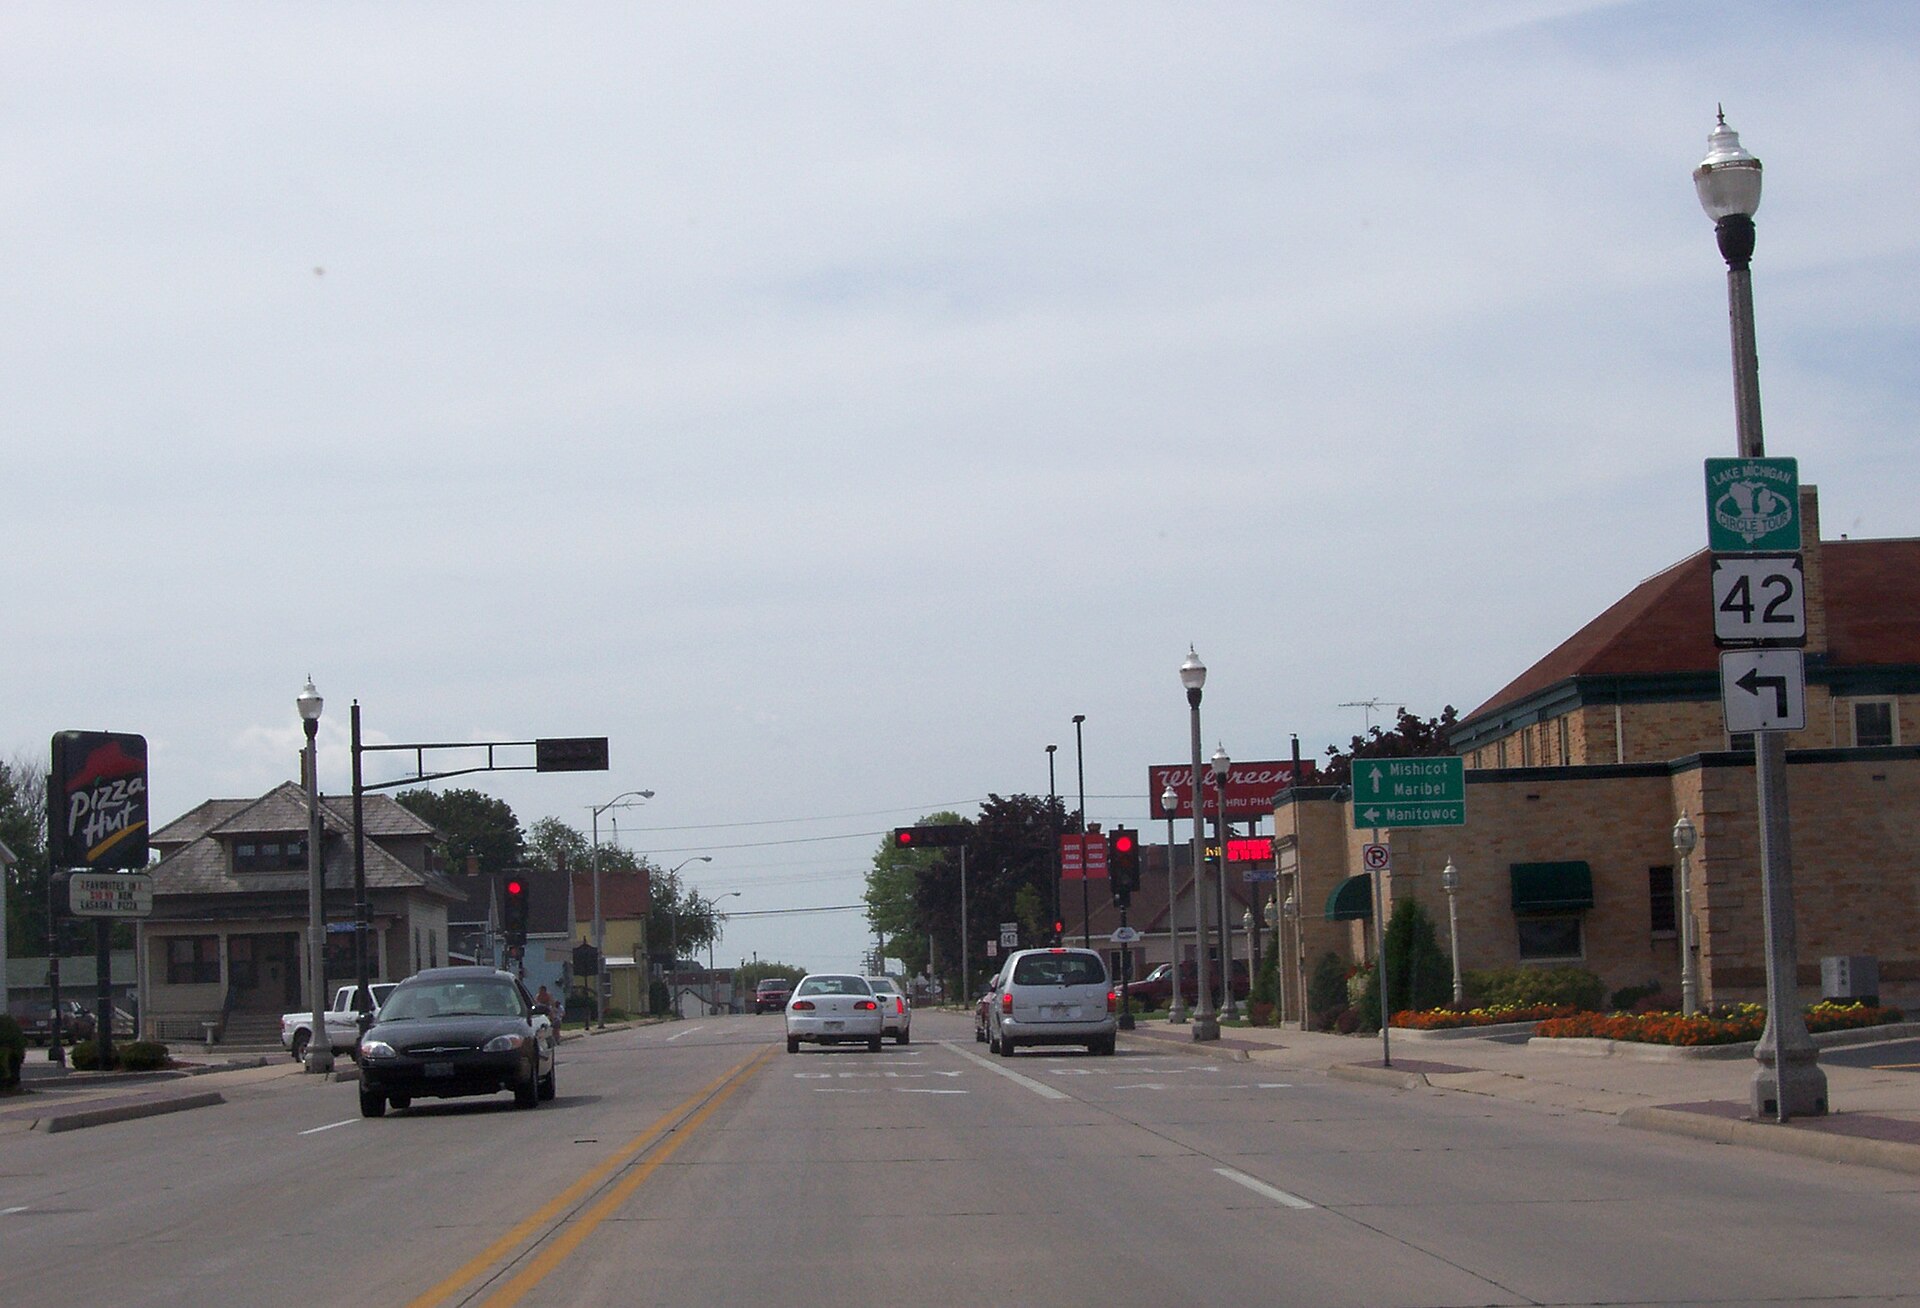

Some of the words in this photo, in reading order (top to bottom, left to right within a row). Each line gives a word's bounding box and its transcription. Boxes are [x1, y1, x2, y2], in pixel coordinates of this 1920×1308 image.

[1712, 467, 1740, 485] LAKE
[1743, 465, 1792, 484] MICHIGAN
[1720, 513, 1758, 532] CIRCLE
[1760, 512, 1788, 532] TOUR
[1720, 574, 1795, 623] 42
[1390, 762, 1448, 776] Mishicot
[1394, 782, 1446, 796] Maribel
[69, 777, 145, 836] Pizza
[1386, 807, 1457, 820] Manitowoc
[83, 801, 139, 847] Hut
[117, 900, 138, 910] PIZZA
